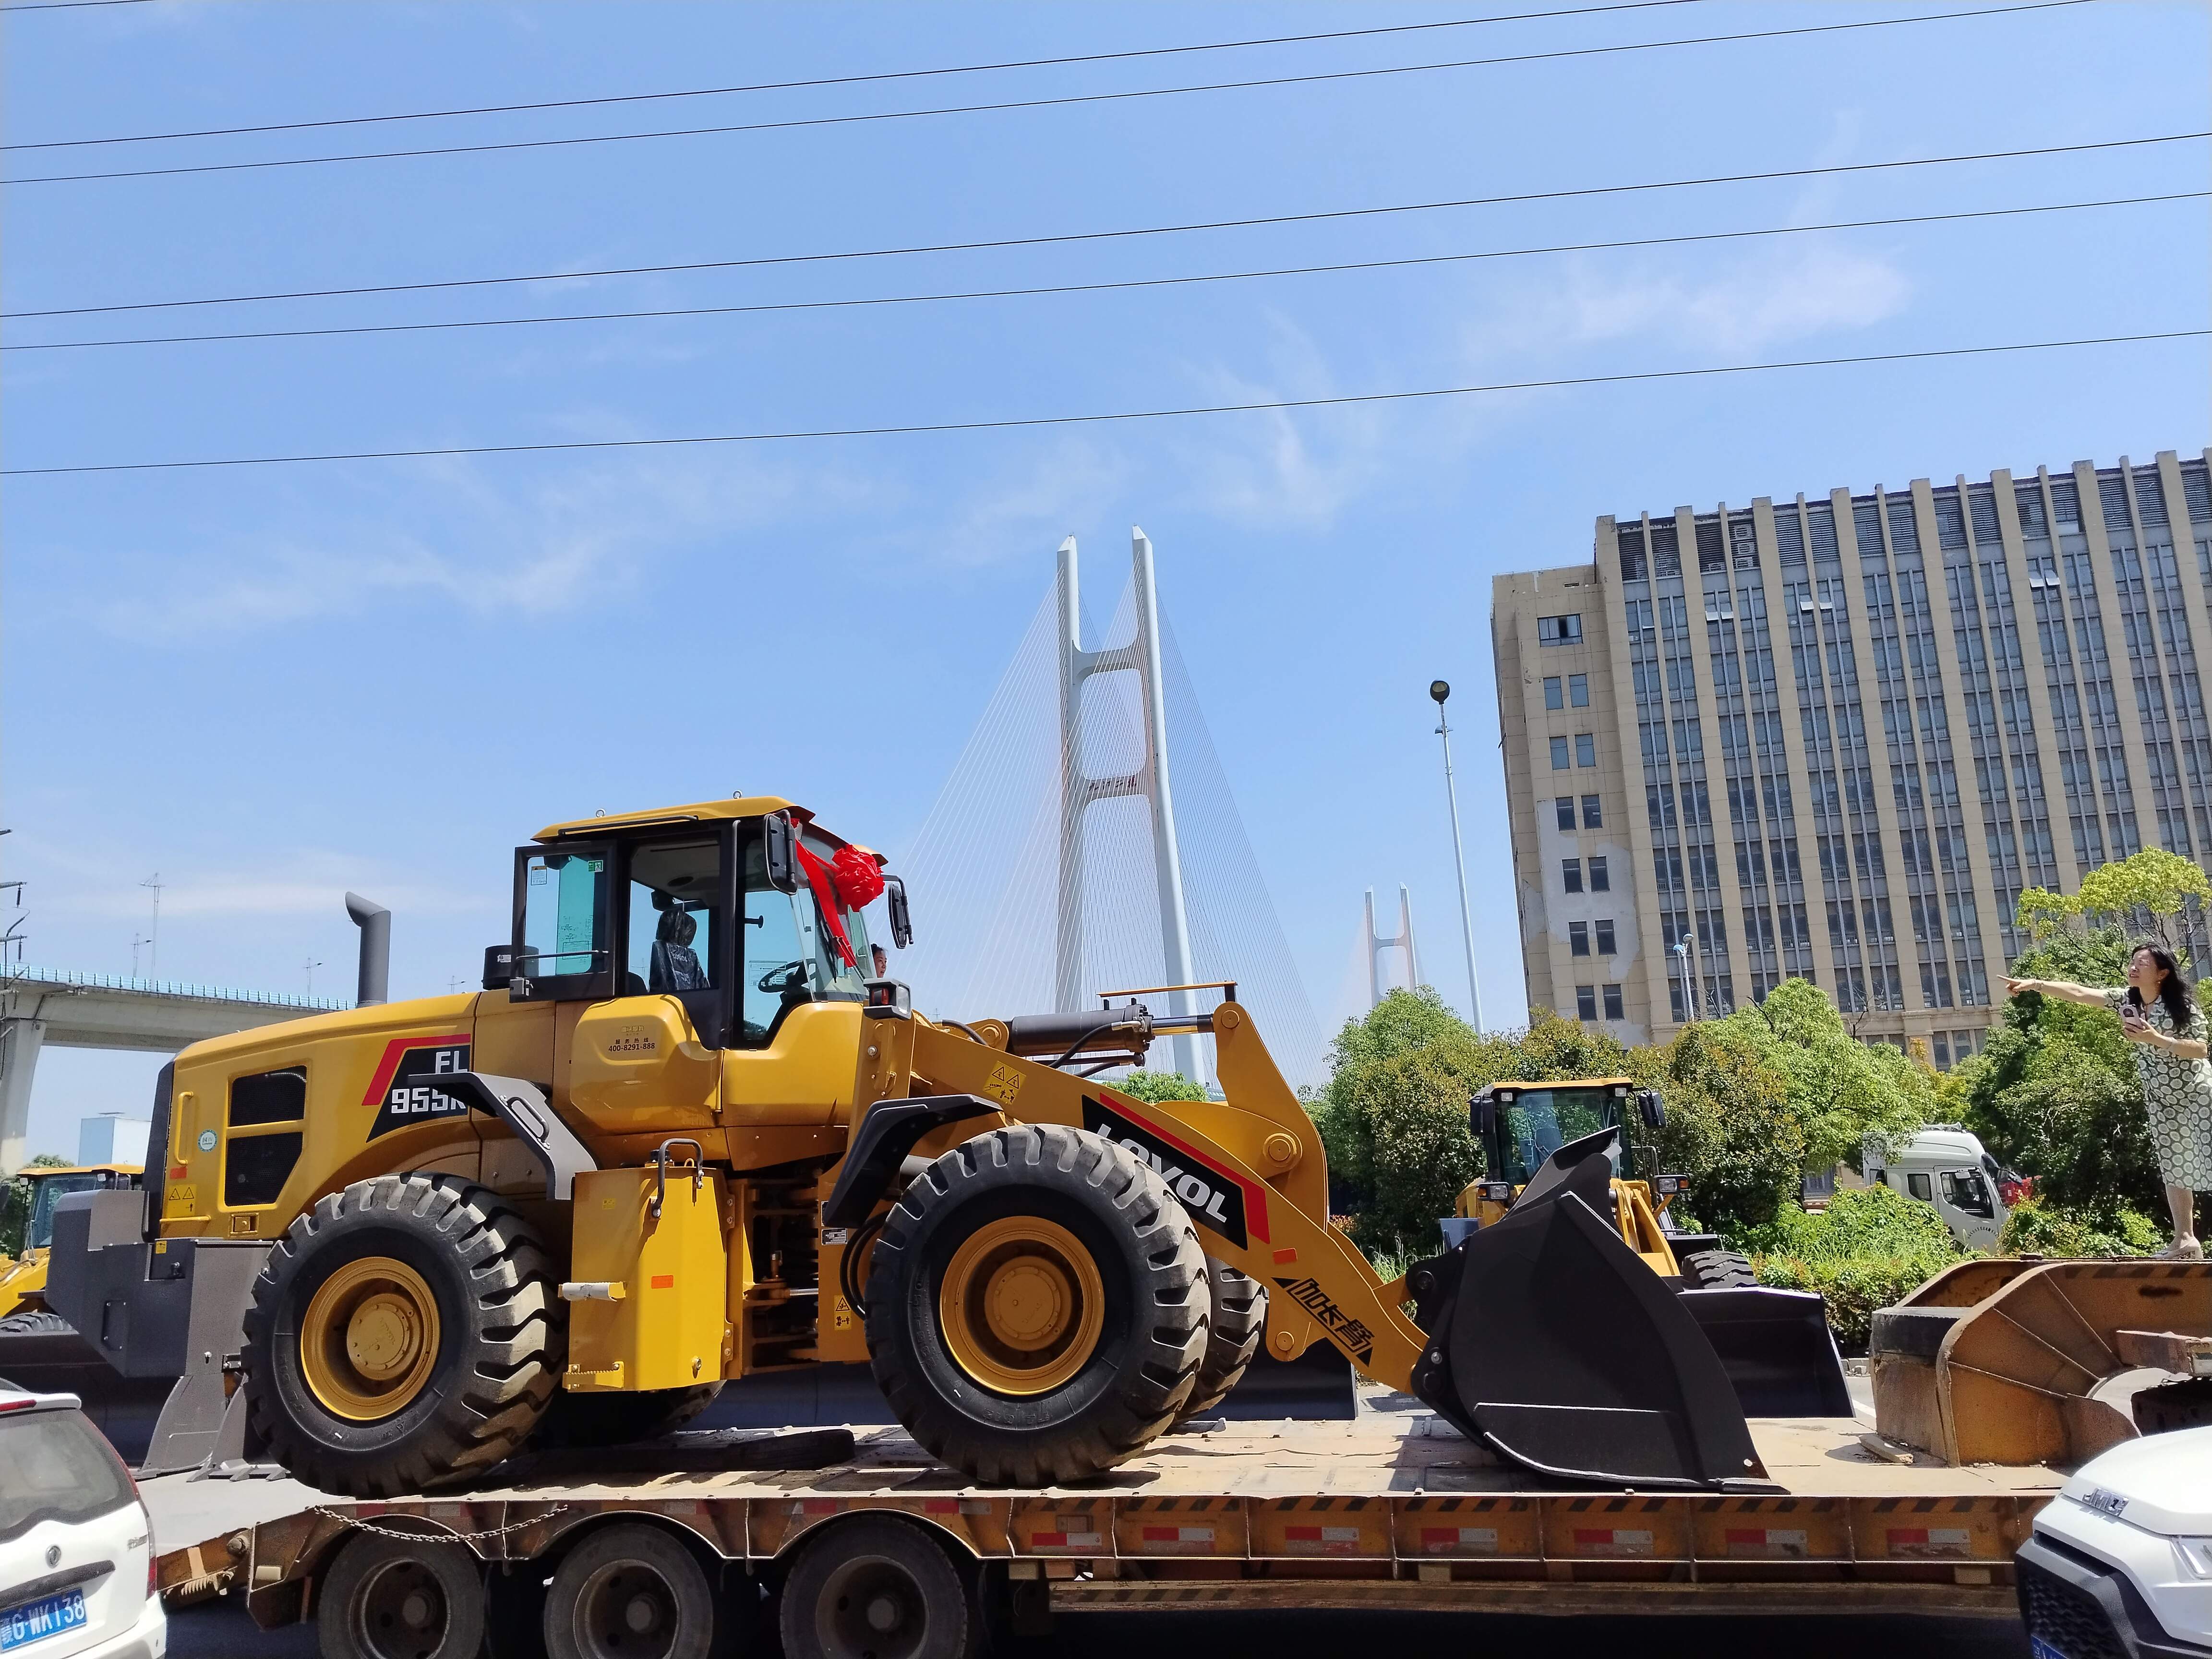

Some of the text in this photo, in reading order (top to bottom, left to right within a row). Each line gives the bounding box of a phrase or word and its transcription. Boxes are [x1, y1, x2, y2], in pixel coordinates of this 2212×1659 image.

[608, 1043, 655, 1052] 400-8291-888
[435, 1051, 468, 1074] FL
[1293, 1280, 1375, 1347] 加长臂
[2081, 1487, 2129, 1517] JMC
